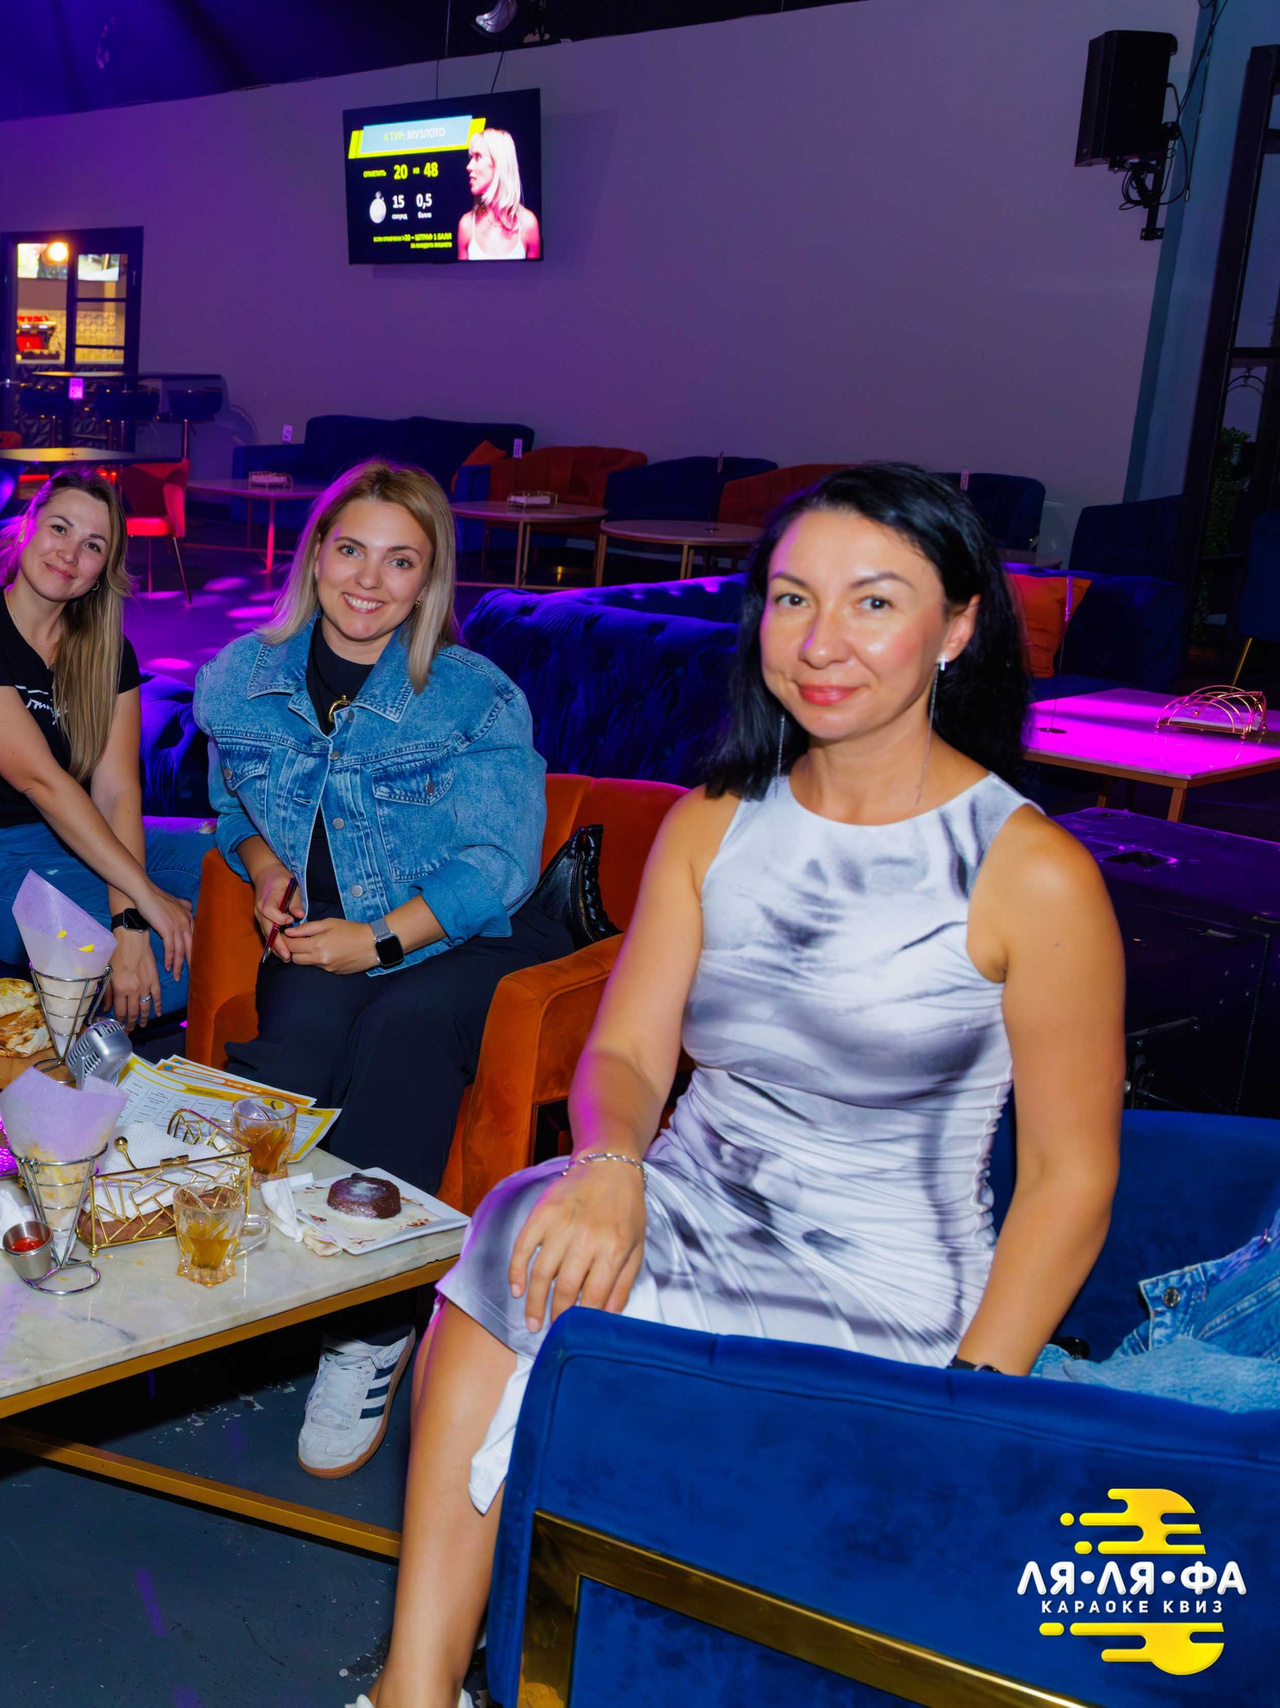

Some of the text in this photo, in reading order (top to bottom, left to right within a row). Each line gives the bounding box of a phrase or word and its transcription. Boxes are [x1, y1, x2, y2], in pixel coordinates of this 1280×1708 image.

[407, 128, 445, 140] МУЗЛОТО
[393, 163, 408, 179] 20
[423, 161, 439, 177] 48
[392, 195, 405, 208] 15
[416, 193, 433, 210] 0,5
